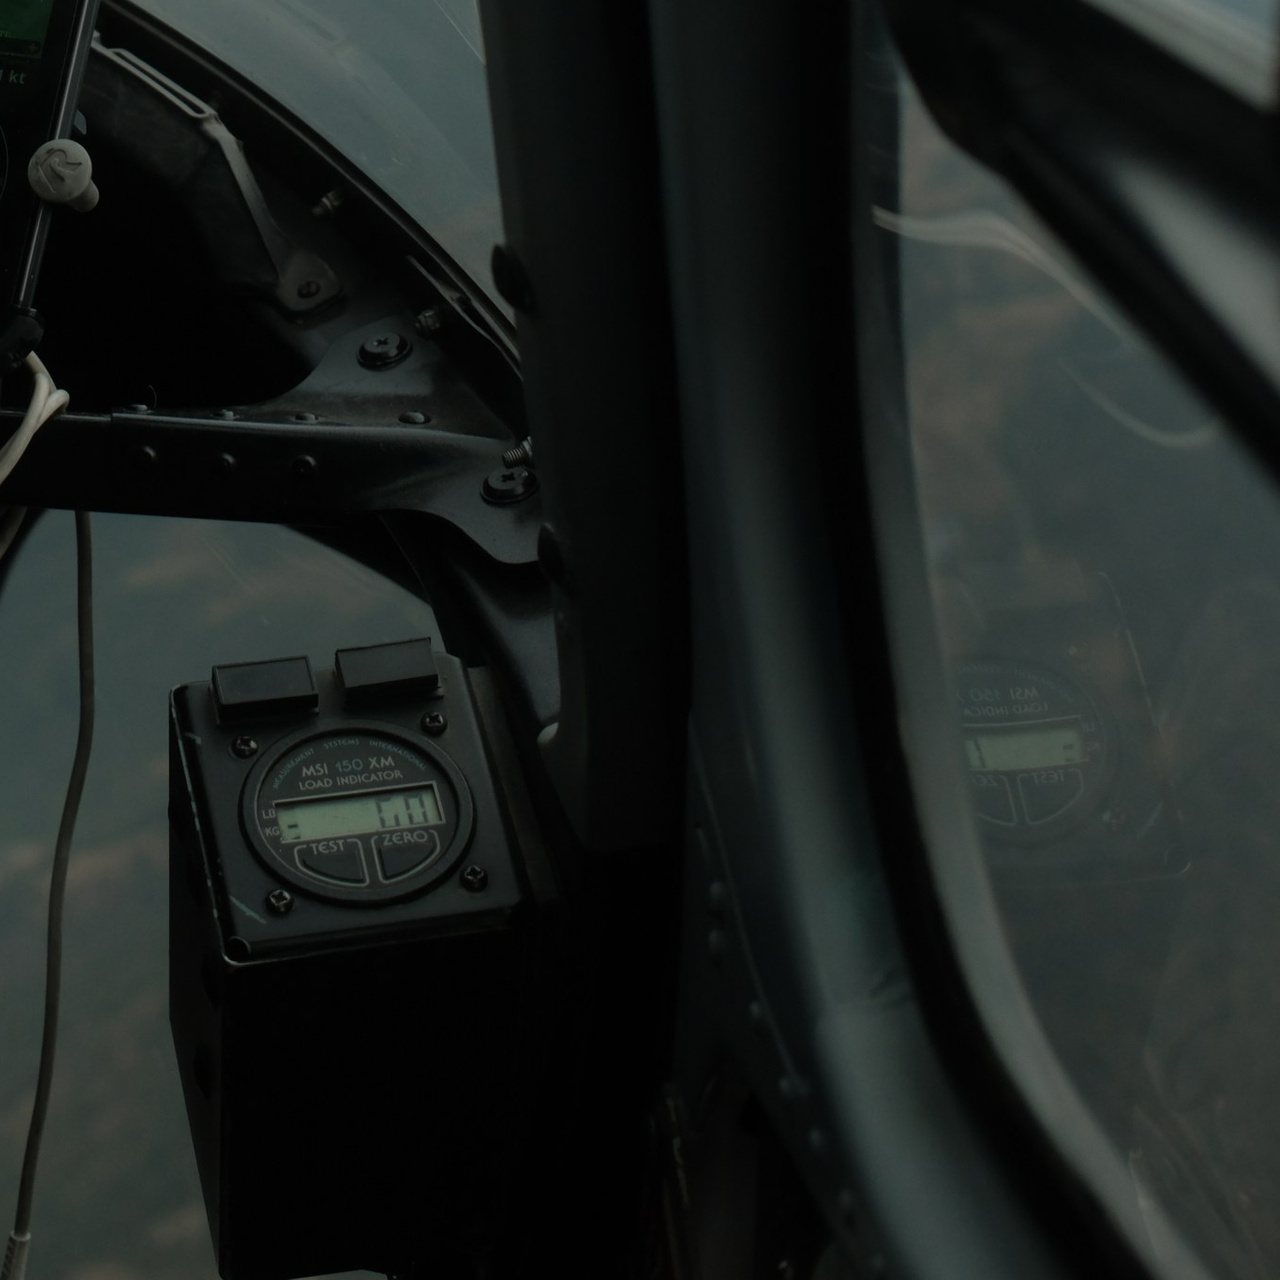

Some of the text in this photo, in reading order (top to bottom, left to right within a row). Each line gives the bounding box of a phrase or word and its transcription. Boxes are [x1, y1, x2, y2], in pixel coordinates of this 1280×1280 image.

[8, 70, 27, 85] kt
[272, 737, 428, 790] MEASUREMENT SYSTEMS INTERNATIONAL
[300, 755, 396, 779] MSI 150 XM
[298, 768, 404, 792] LOAD INDICATOR
[261, 808, 277, 821] LB
[264, 825, 281, 838] KG
[382, 830, 429, 847] ZERO
[309, 840, 346, 857] TEST
